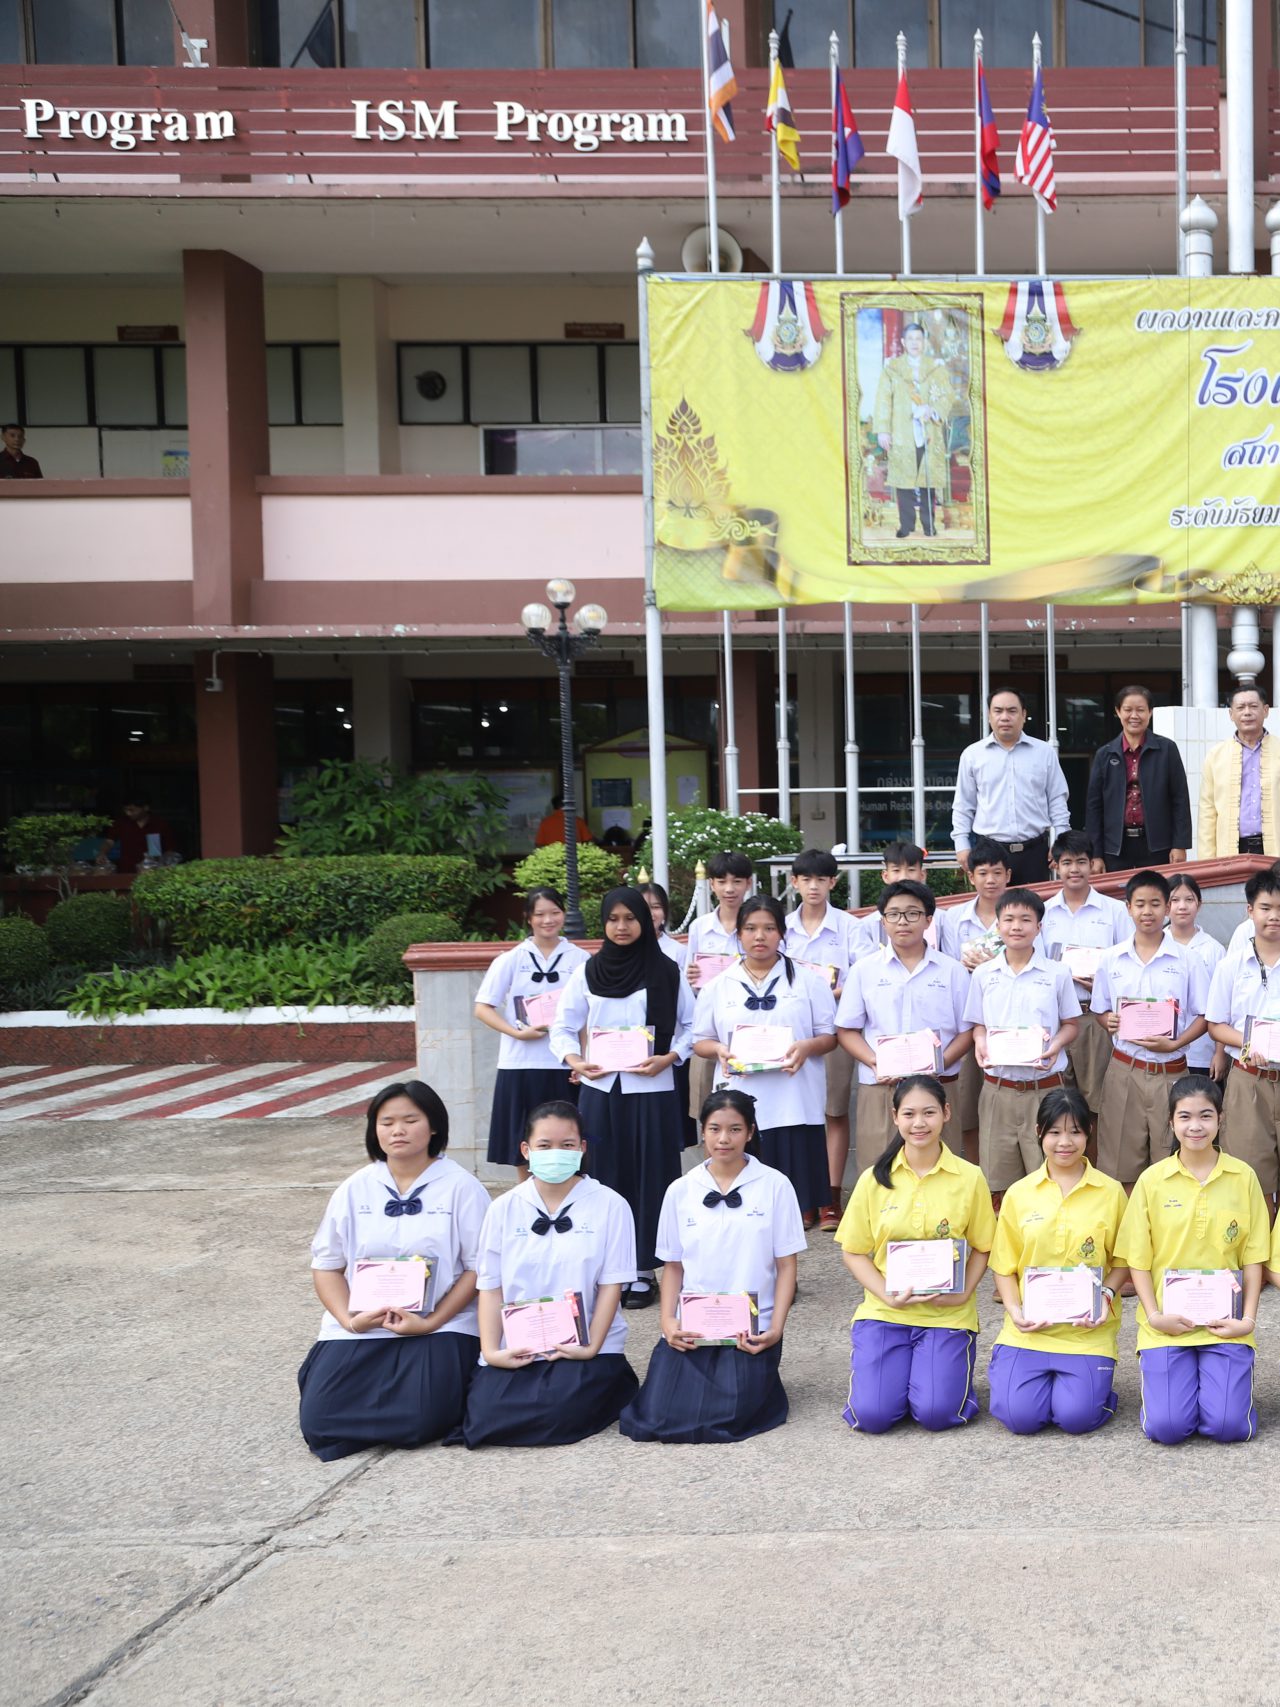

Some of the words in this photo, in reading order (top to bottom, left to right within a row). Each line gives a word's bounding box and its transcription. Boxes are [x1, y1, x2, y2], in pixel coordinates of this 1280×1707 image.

[20, 99, 236, 150] Program
[352, 100, 460, 141] ISM
[495, 101, 689, 152] Program
[935, 801, 953, 812] Dep
